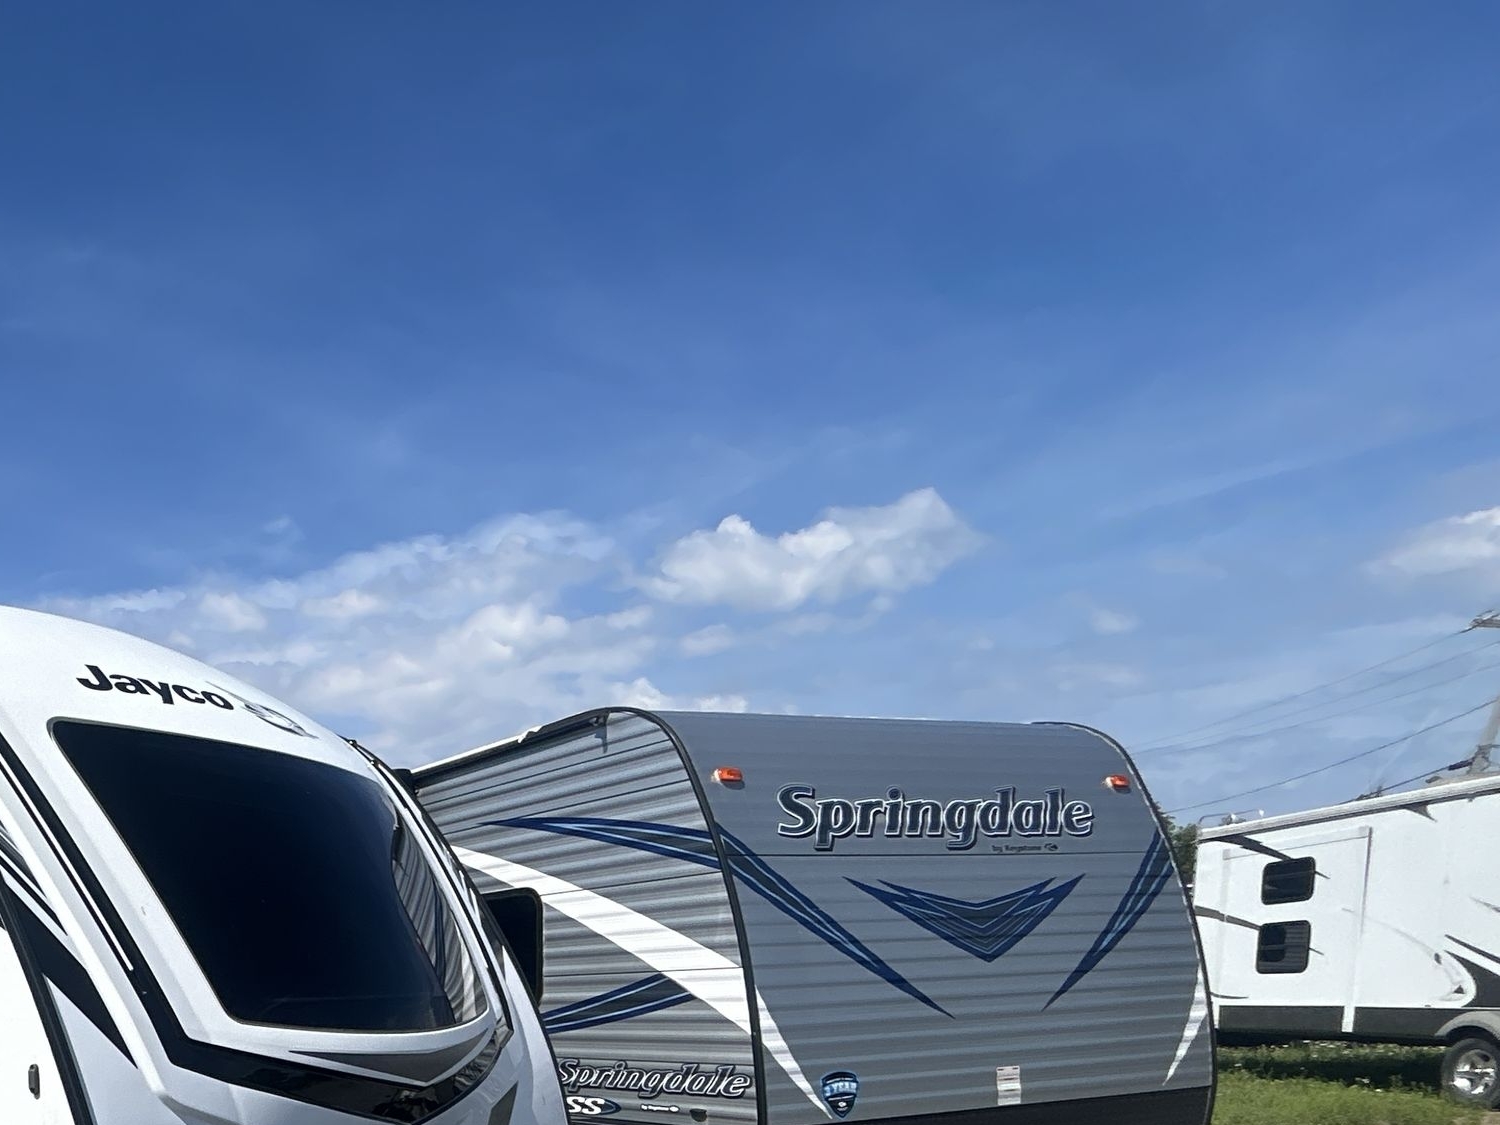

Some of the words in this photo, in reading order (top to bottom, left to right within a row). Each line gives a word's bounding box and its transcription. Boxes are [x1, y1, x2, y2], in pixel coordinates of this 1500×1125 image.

[75, 663, 235, 711] Jayco
[777, 783, 1096, 851] Springdale
[558, 1058, 752, 1098] Springdale
[566, 1096, 606, 1115] SS
